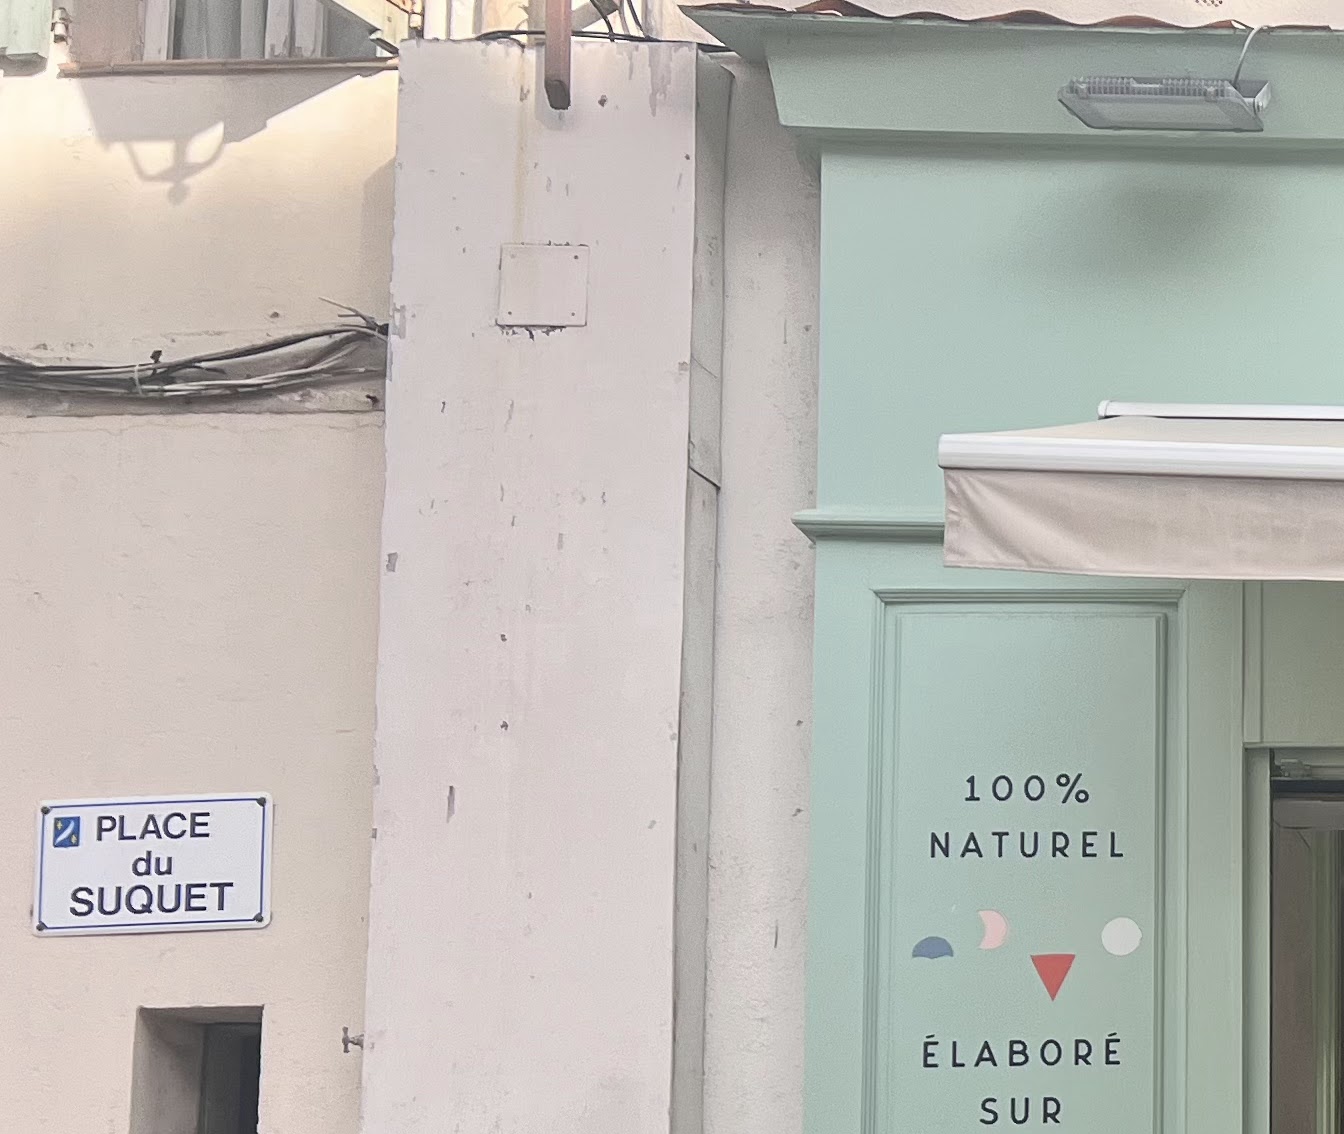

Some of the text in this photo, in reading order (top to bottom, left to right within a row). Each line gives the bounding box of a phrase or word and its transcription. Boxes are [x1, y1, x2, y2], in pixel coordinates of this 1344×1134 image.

[964, 773, 1090, 803] 100%
[95, 811, 211, 841] PLACE
[930, 831, 1124, 858] NATUREL
[131, 850, 173, 876] du
[69, 882, 234, 917] SUQUET
[922, 1033, 1121, 1068] ÉLABORÉ
[980, 1097, 1061, 1125] SUR
